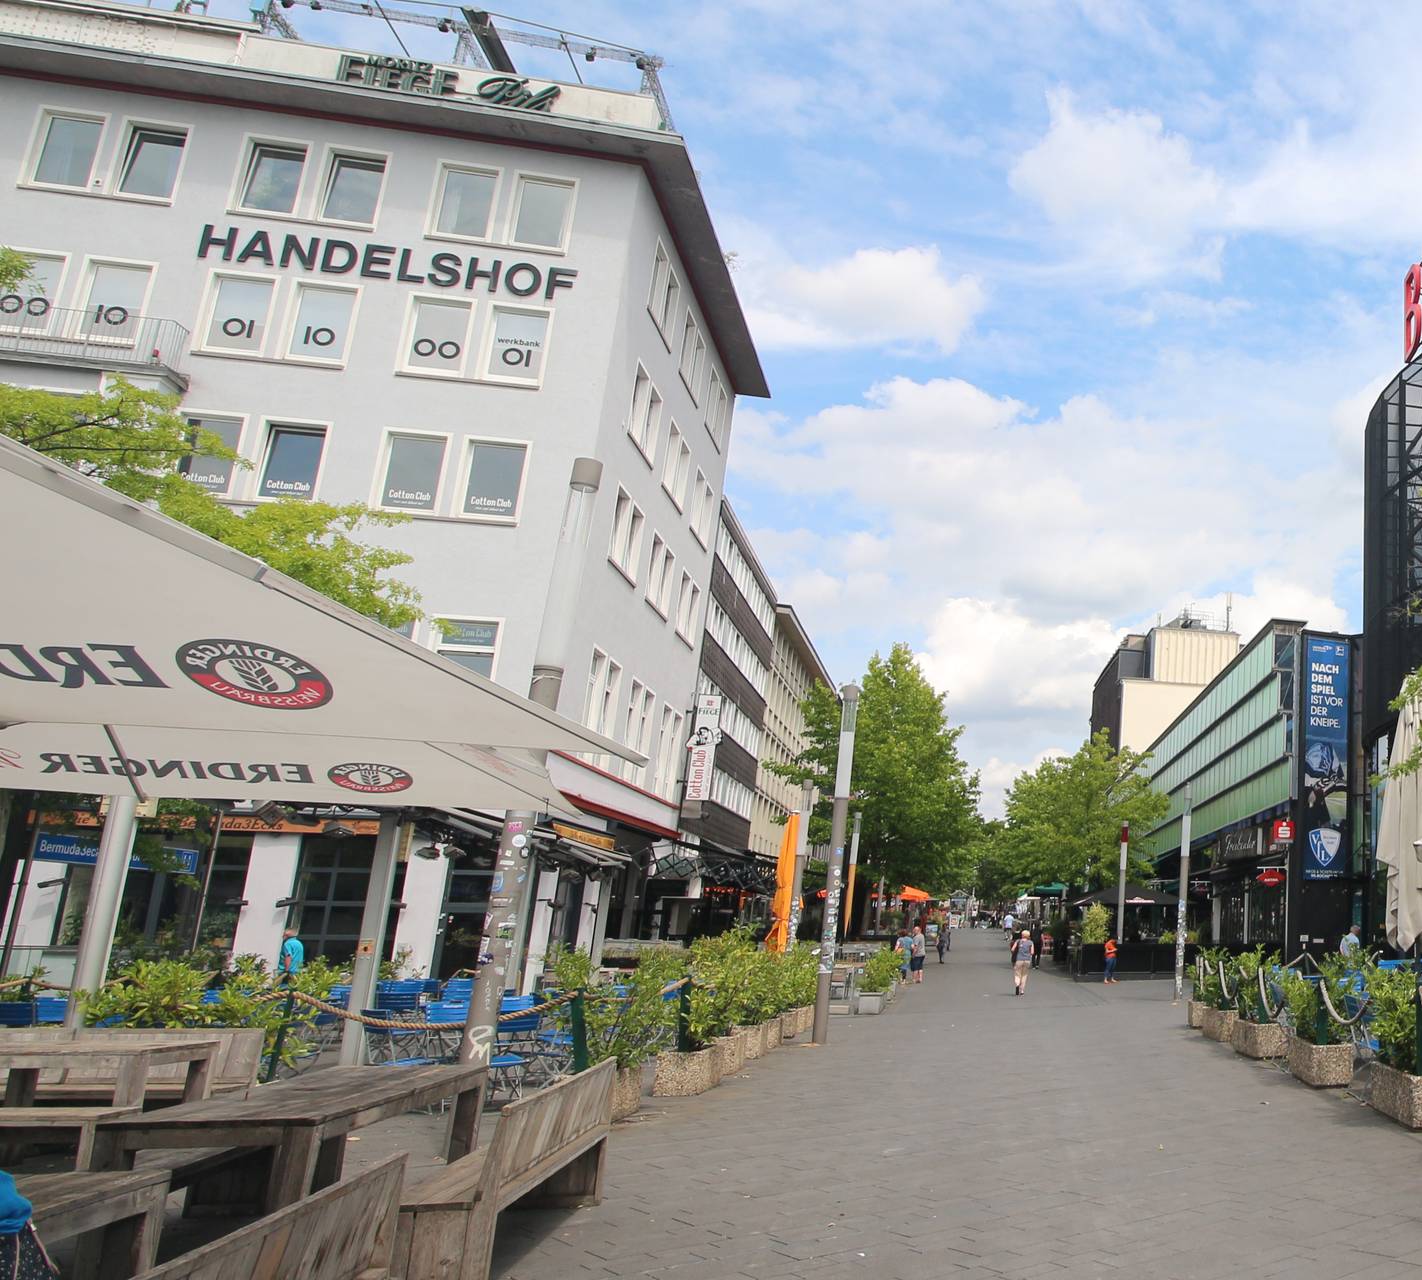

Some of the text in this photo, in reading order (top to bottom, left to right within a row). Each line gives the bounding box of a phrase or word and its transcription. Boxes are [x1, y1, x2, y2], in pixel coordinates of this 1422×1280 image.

[197, 224, 579, 300] HANDELSHOF
[497, 337, 541, 348] werkbank
[208, 473, 225, 485] Club
[266, 479, 311, 492] Cotton Club
[388, 489, 431, 501] Cotton Club
[470, 496, 512, 508] Cotton Club
[1311, 662, 1339, 674] NACH
[1311, 673, 1333, 684] DEM
[1311, 684, 1336, 695] SPIEL
[1311, 694, 1343, 707] IST VOR
[1310, 705, 1328, 717] DER
[1310, 716, 1341, 729] KNEIPE.
[688, 749, 707, 799] Cotton Club
